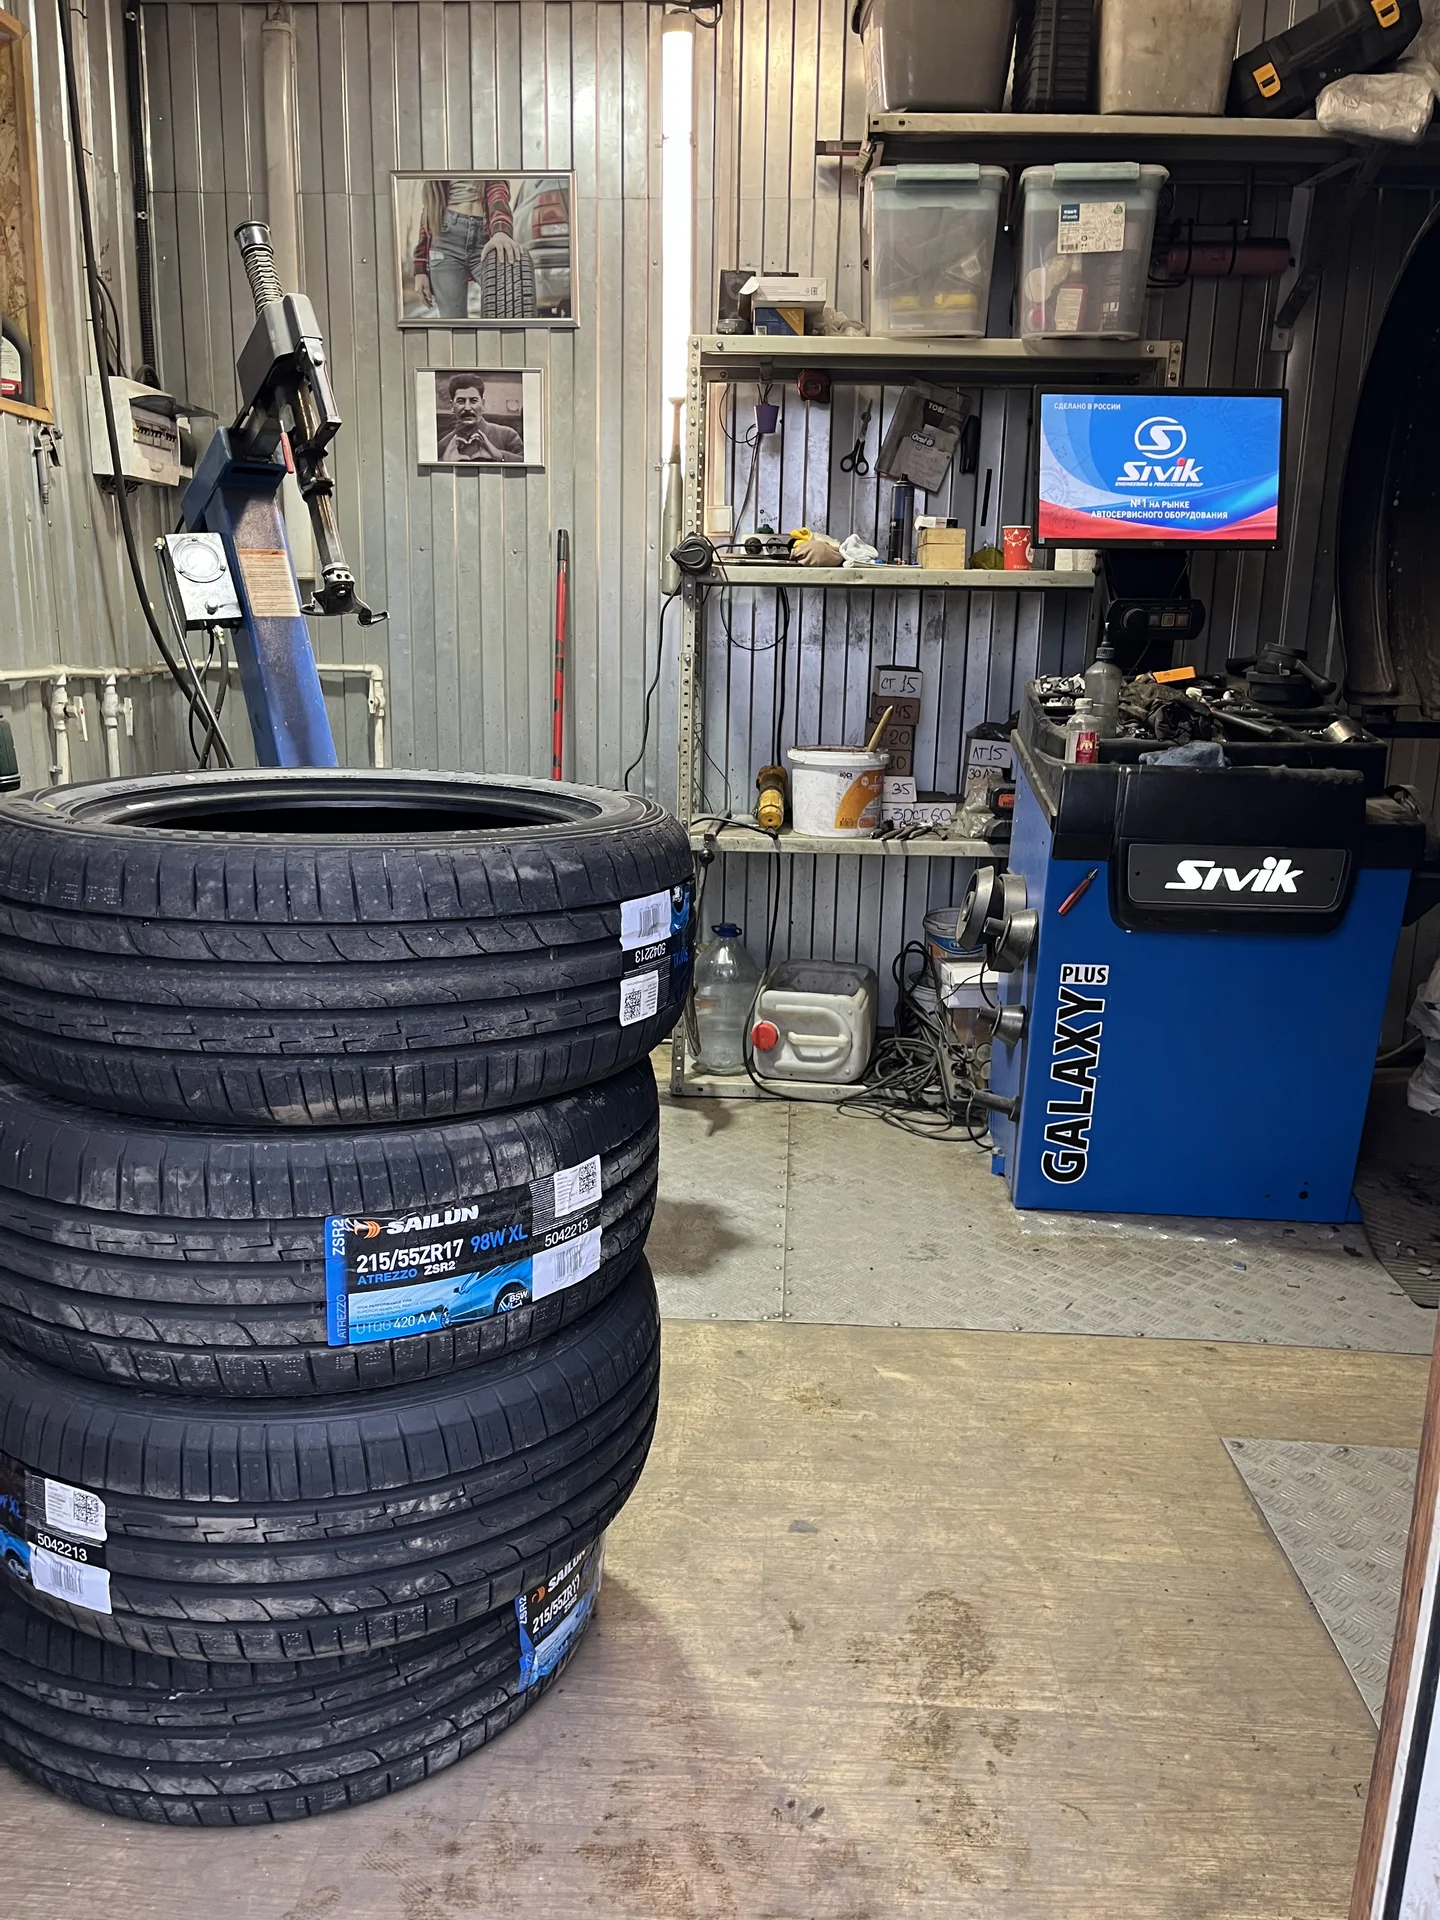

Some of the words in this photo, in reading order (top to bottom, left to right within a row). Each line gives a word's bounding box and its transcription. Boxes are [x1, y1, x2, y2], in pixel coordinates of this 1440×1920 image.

[1053, 402, 1086, 411] СДЕЛАНО
[1088, 402, 1092, 411] В
[1093, 403, 1121, 411] РОССИИ
[1149, 500, 1160, 508] НА
[1162, 501, 1190, 509] РЫНКЕ
[1091, 510, 1162, 519] АВТОСЕРВИСНОГО
[1164, 511, 1228, 520] ОБОРУДОВАНИЯ
[899, 674, 919, 693] 15
[895, 704, 913, 719] 45
[889, 730, 911, 745] 20
[967, 768, 982, 780] 30
[891, 782, 914, 795] 35
[931, 807, 951, 822] 60
[635, 942, 667, 964] 5042213
[1062, 966, 1107, 984] PLUS
[1041, 986, 1105, 1184] GALAXY
[386, 1204, 479, 1235] SAILUN
[332, 1217, 346, 1256] ZSR2
[545, 1219, 589, 1248] 5042213
[356, 1238, 464, 1274] 215/55ZR17
[470, 1230, 505, 1253] 98W
[507, 1223, 528, 1242] XL
[357, 1267, 417, 1285] ATREZZO
[423, 1260, 456, 1275] ZSR2
[368, 1300, 401, 1308] PERFORMANCE
[509, 1290, 528, 1303] BSW
[336, 1294, 347, 1339] ATREZZO
[393, 1315, 415, 1328] 420
[417, 1313, 427, 1325] A
[428, 1311, 438, 1323] A
[37, 1532, 88, 1562] 5042213
[532, 1573, 580, 1634] 215/55ZR17
